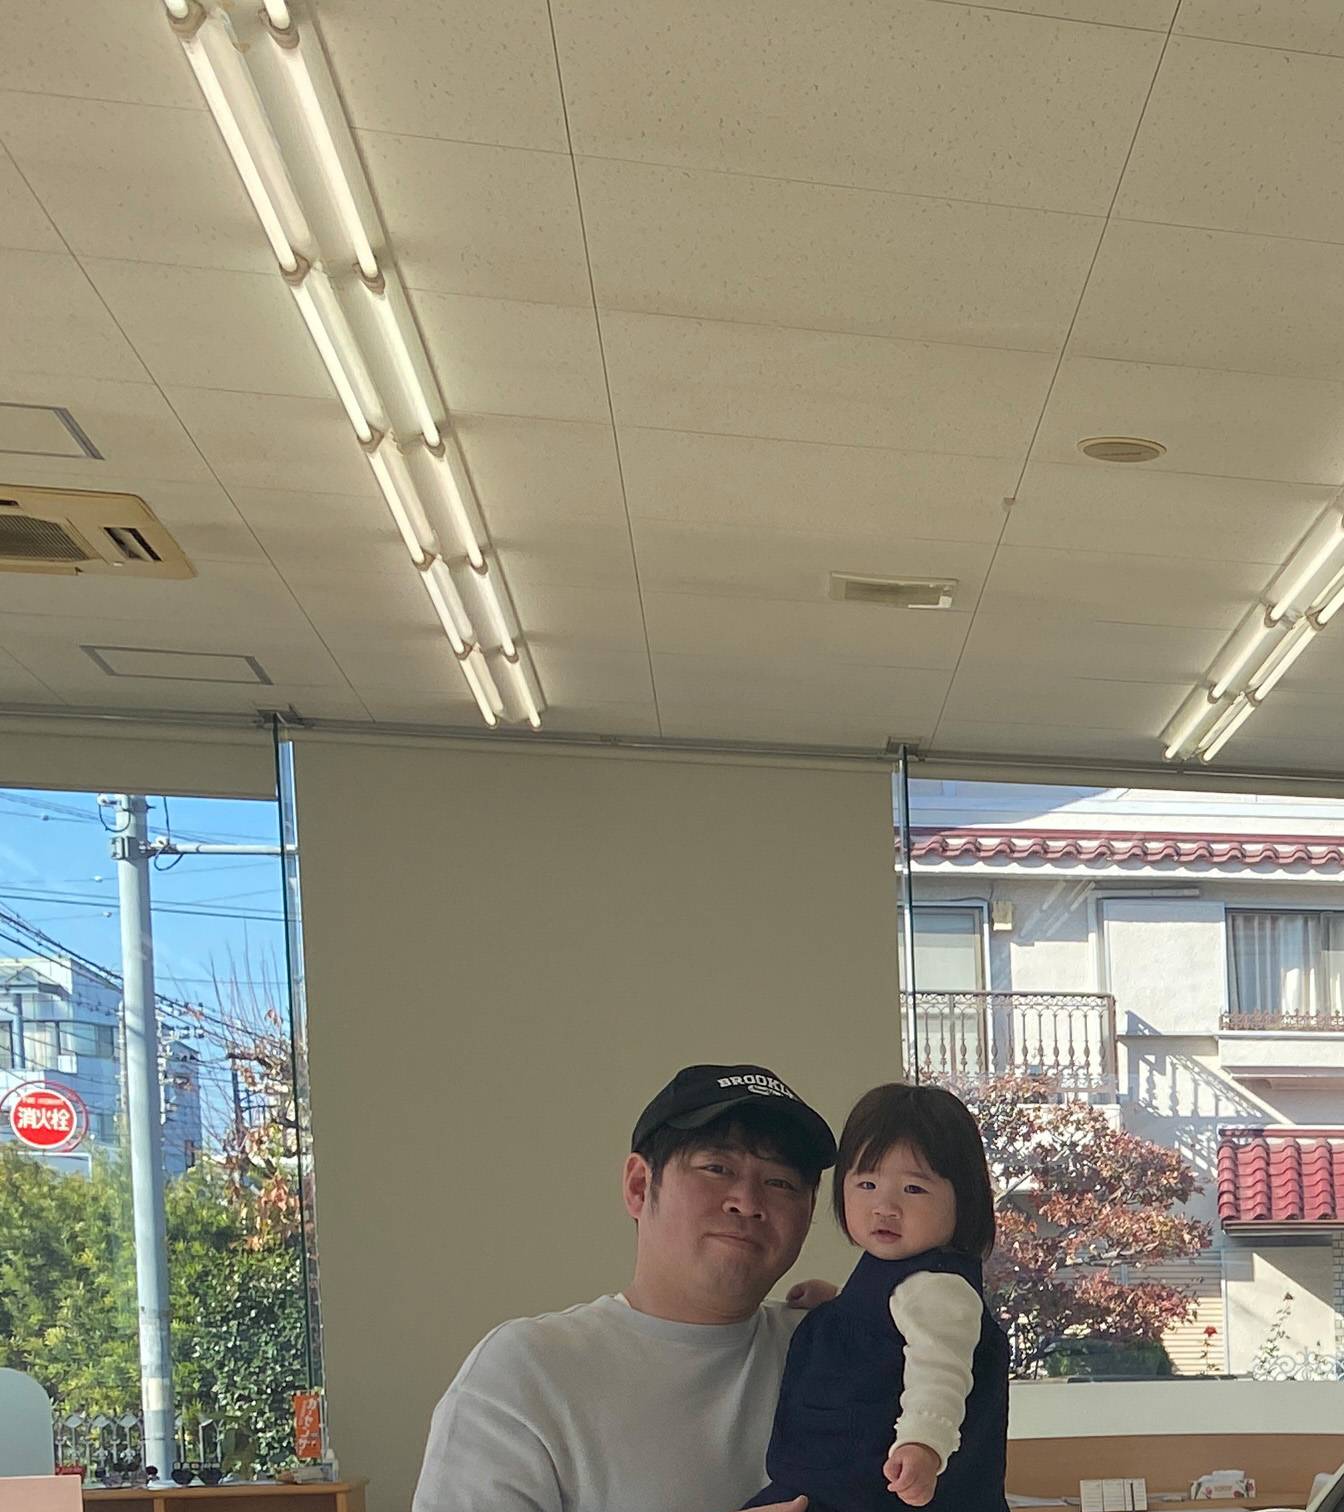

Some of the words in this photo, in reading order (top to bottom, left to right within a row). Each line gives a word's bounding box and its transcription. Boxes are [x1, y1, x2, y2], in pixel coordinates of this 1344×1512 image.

[717, 1075, 798, 1101] BROOKL
[17, 1107, 70, 1131] 消火栓
